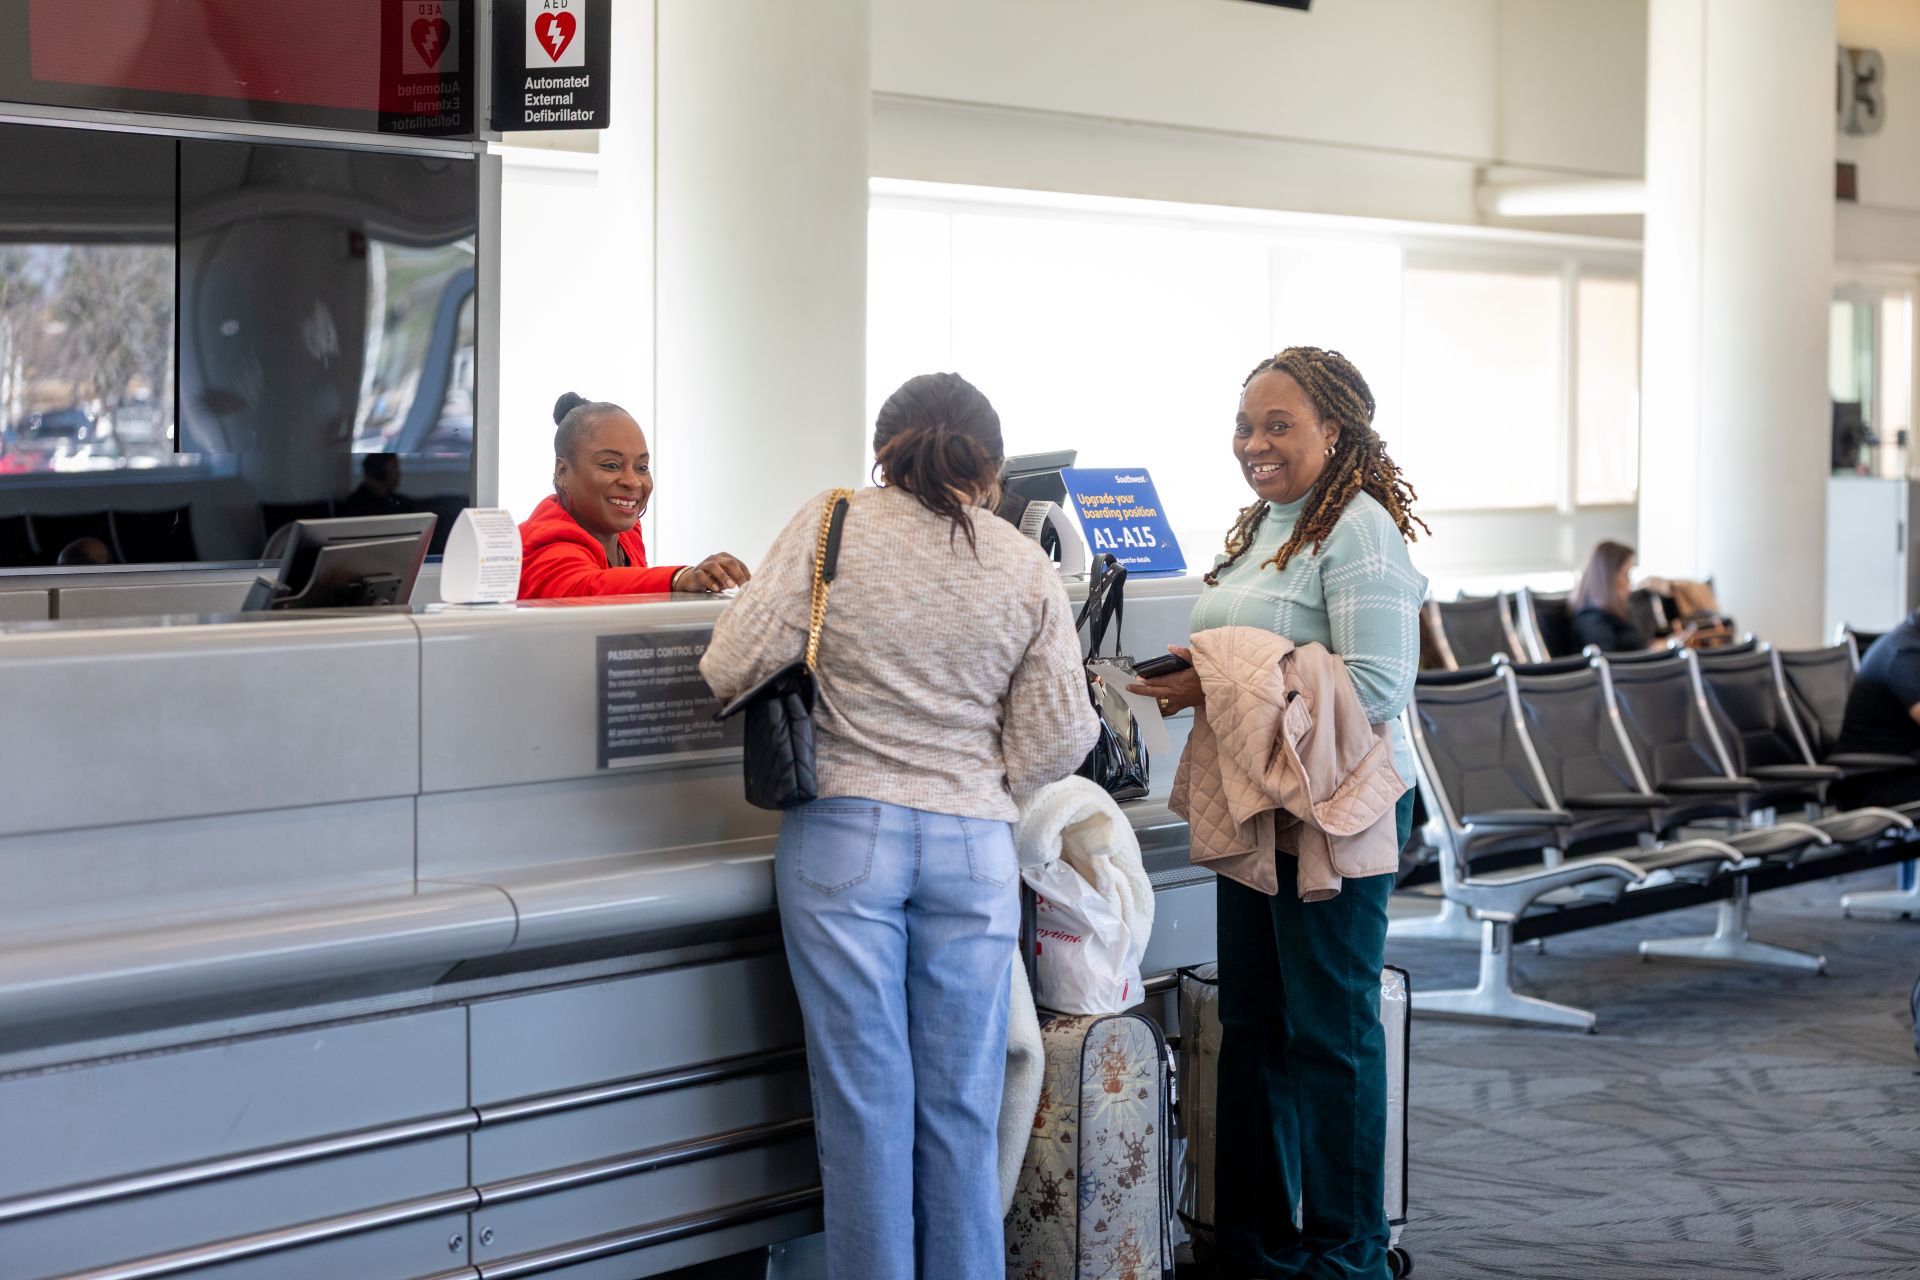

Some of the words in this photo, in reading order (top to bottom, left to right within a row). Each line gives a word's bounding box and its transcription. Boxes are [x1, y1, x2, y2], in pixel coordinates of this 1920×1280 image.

[543, 0, 568, 9] AED
[524, 75, 590, 90] Automated
[524, 92, 574, 106] External
[524, 108, 595, 123] Defibrillator
[1077, 492, 1115, 508] Upgrade
[1114, 495, 1134, 507] your
[1082, 506, 1123, 521] boarding
[1122, 505, 1158, 521] position
[1093, 526, 1157, 549] A1-A15
[608, 648, 655, 662] PASSENGER
[656, 645, 693, 658] CONTROL
[694, 645, 705, 655] OF
